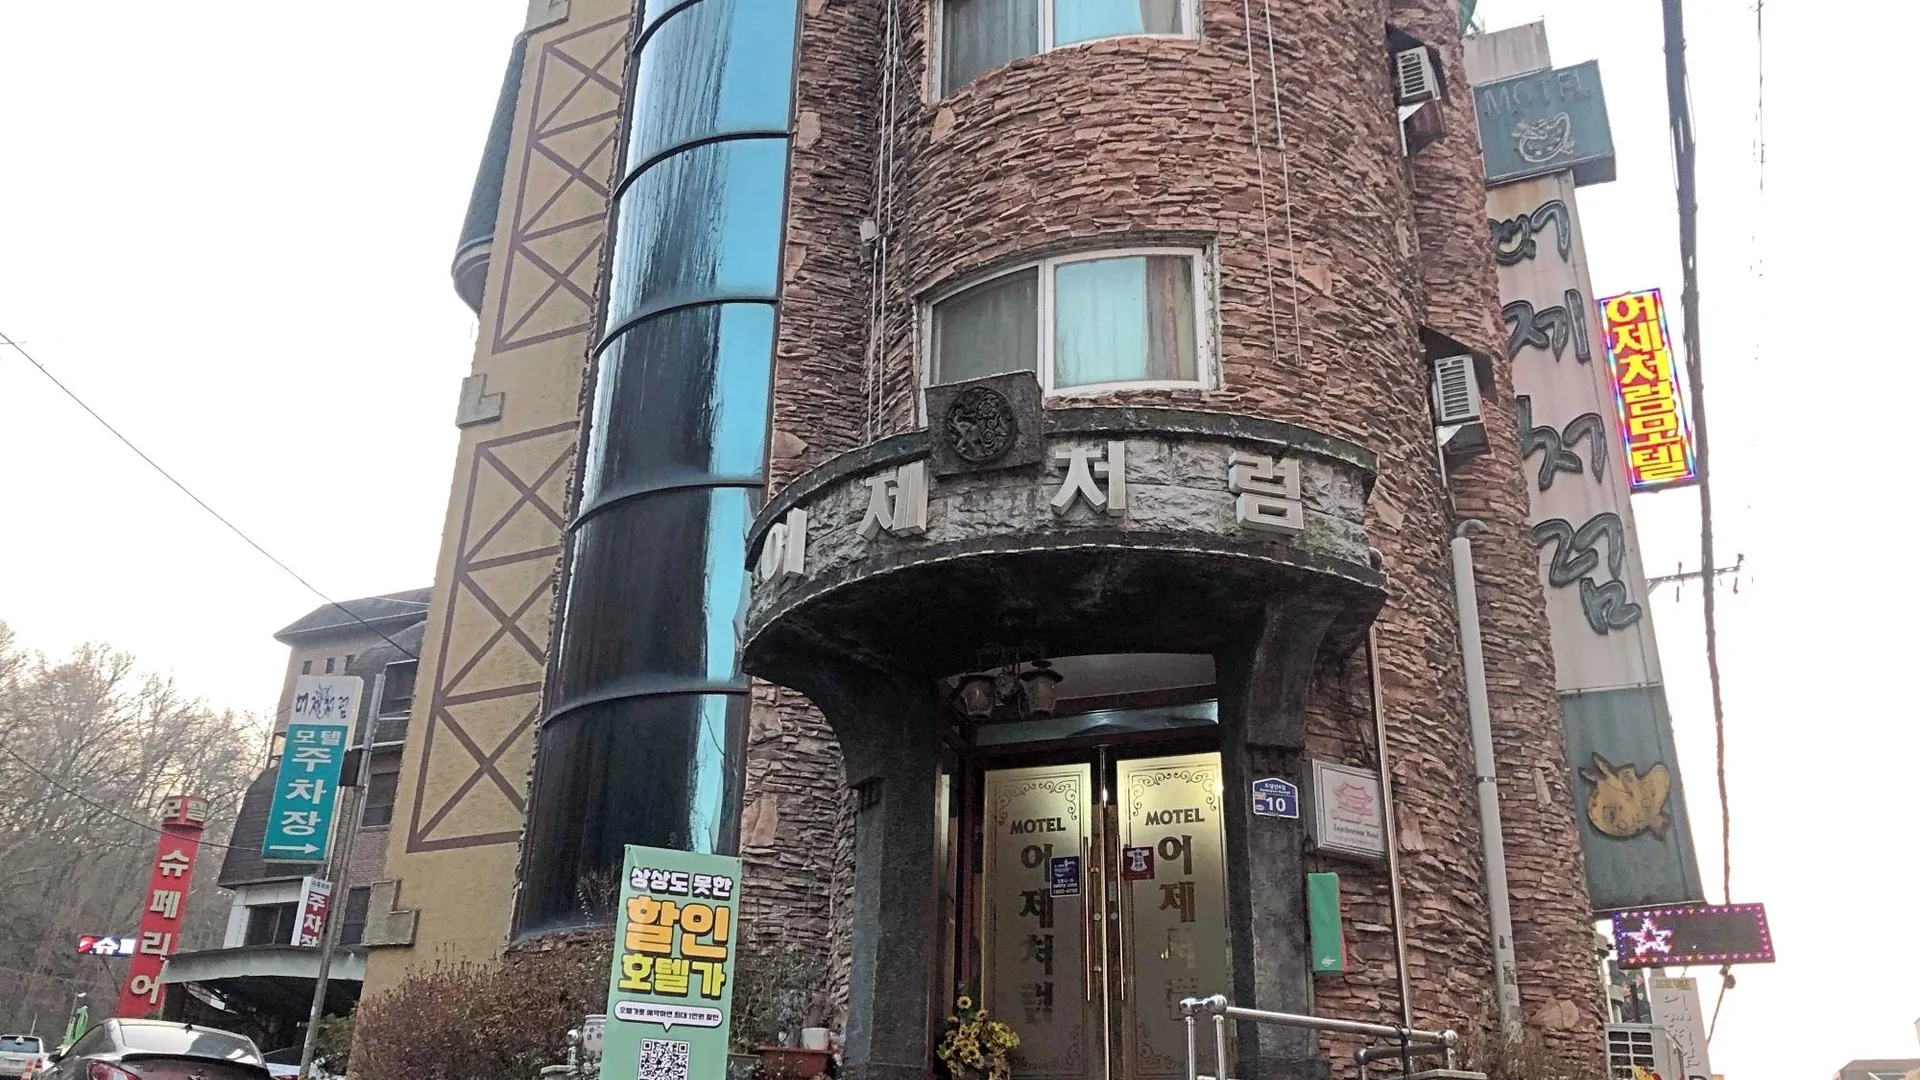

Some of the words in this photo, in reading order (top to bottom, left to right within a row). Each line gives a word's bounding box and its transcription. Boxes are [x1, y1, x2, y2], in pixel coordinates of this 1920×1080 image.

[1484, 69, 1593, 115] MOTEL
[761, 440, 1304, 580] 어제처럼
[293, 731, 342, 746] 모텔
[160, 799, 209, 821] 모텔
[281, 747, 332, 836] 주차장
[1265, 797, 1286, 812] 10
[1010, 817, 1066, 835] MOTEL
[1145, 808, 1205, 826] MOTEL
[630, 867, 689, 894] 상상도
[693, 873, 733, 900] 못한
[130, 850, 189, 1005] 슈페리어
[624, 895, 731, 961] 할인
[618, 953, 726, 1001] 호텔가
